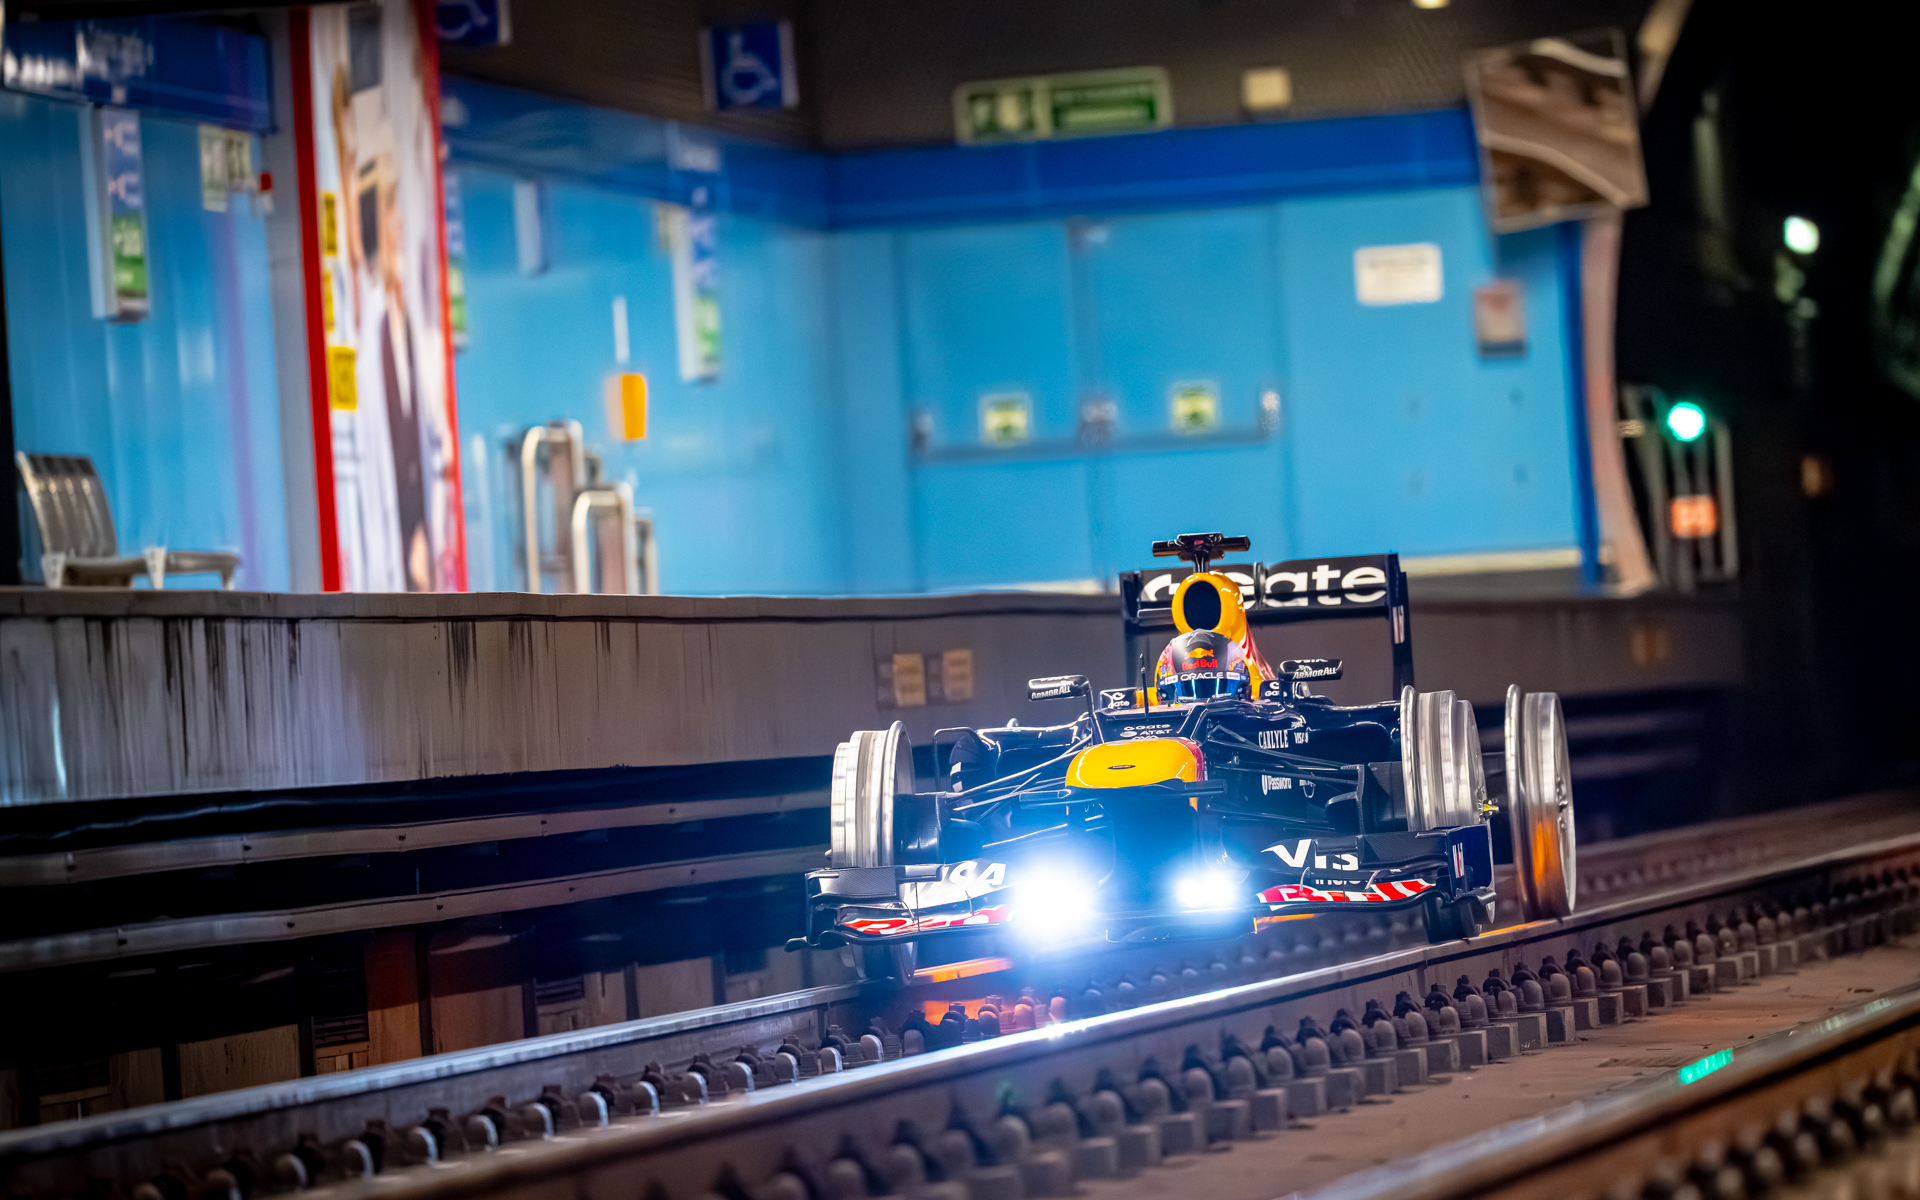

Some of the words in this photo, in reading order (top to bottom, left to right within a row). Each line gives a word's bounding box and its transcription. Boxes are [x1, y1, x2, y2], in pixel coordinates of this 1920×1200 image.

[1182, 661, 1199, 671] Red
[1201, 658, 1218, 668] Bull
[1180, 671, 1224, 681] ORACLE
[1139, 729, 1173, 737] AT&T
[1258, 729, 1289, 749] CARLYLE
